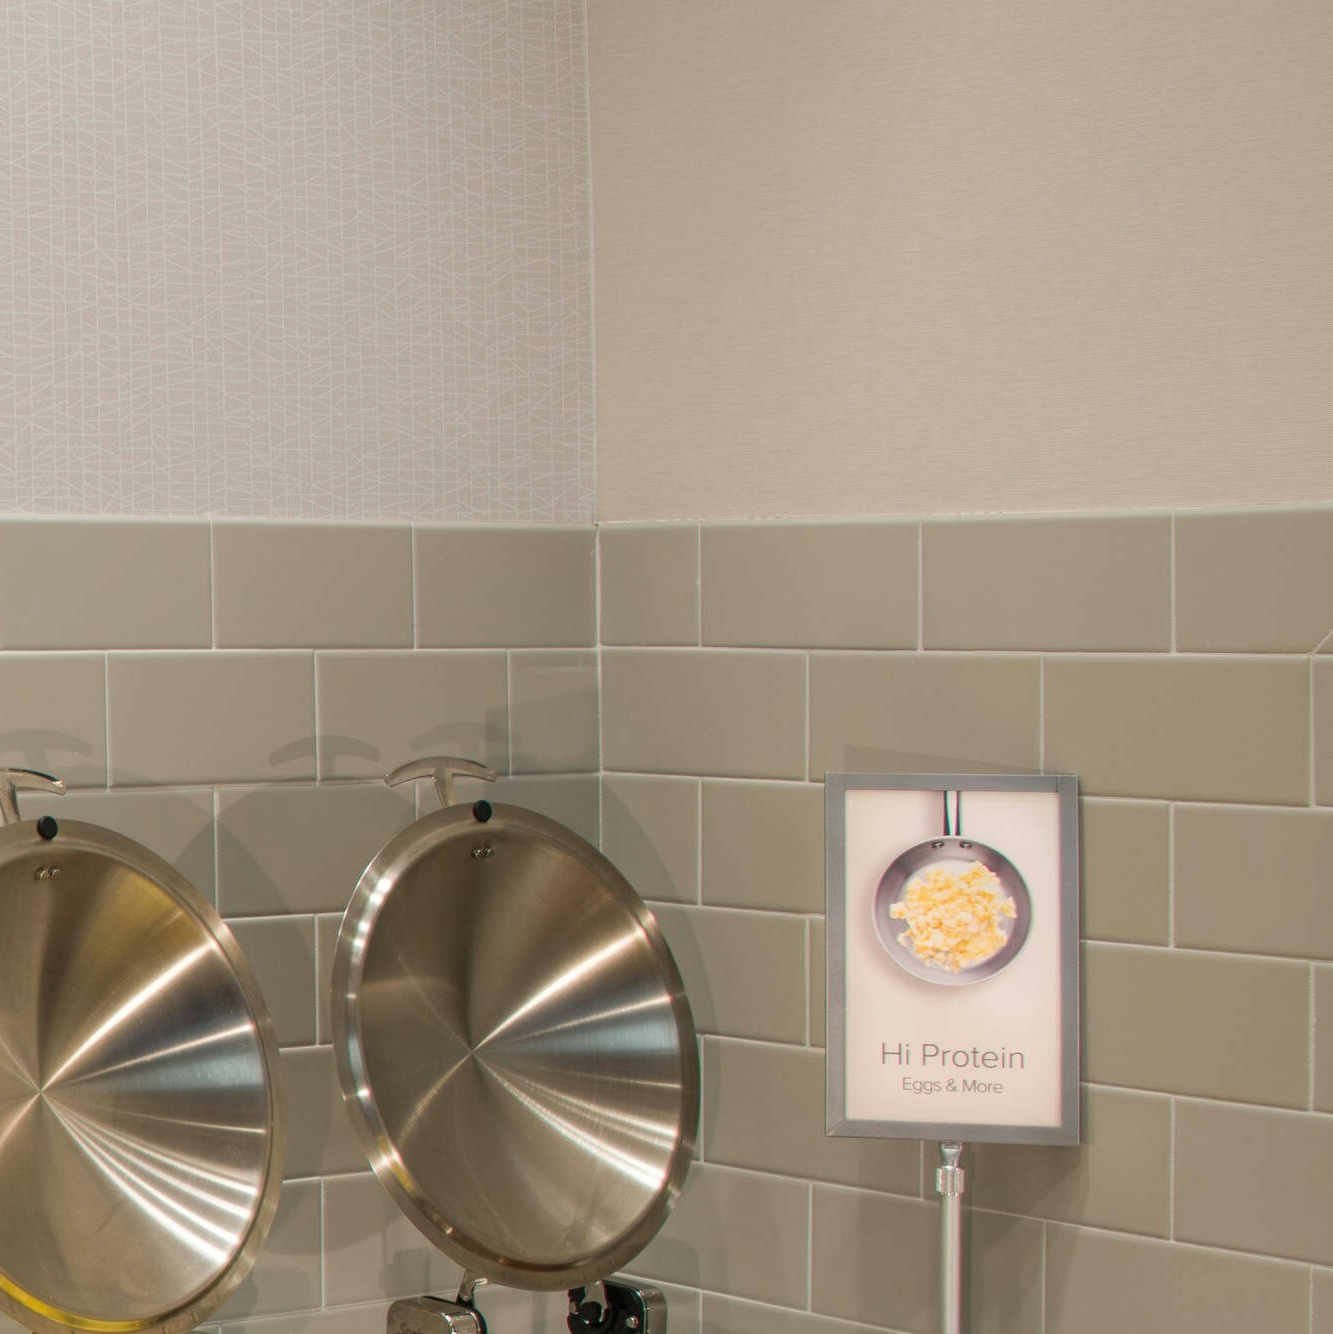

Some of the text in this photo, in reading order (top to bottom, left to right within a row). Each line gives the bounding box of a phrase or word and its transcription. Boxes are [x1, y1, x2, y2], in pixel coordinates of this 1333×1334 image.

[880, 1041, 1025, 1069] Hi Protein
[901, 1076, 1004, 1094] Eggs & More
